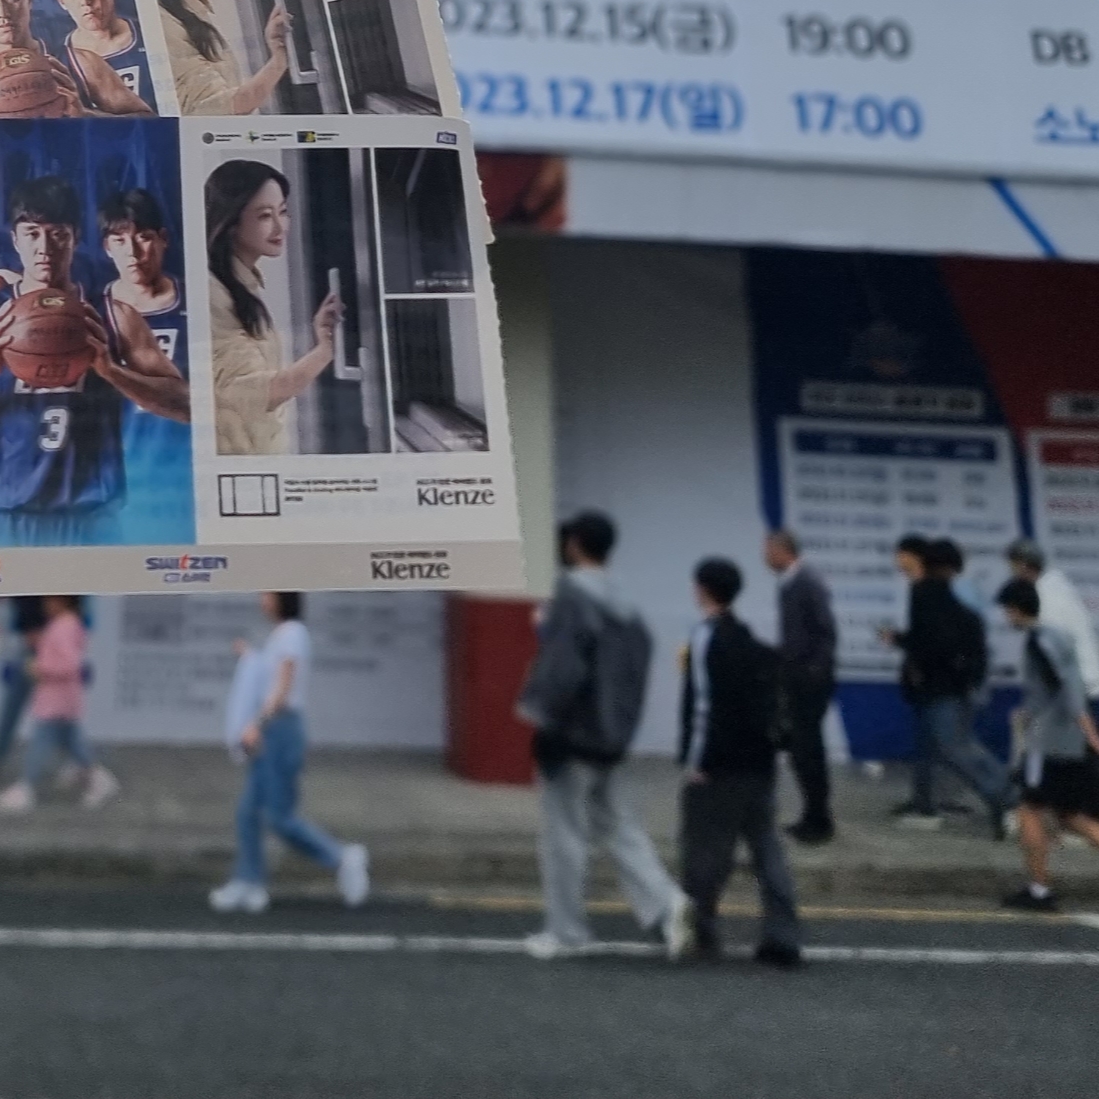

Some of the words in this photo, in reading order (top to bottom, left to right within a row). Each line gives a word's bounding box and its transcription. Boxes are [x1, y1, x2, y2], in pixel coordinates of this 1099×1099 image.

[785, 14, 913, 62] 19:00
[1032, 28, 1091, 67] DB
[791, 90, 925, 142] 17:00
[39, 407, 68, 451] 3
[417, 487, 496, 506] Klenze
[371, 559, 450, 581] Klenze
